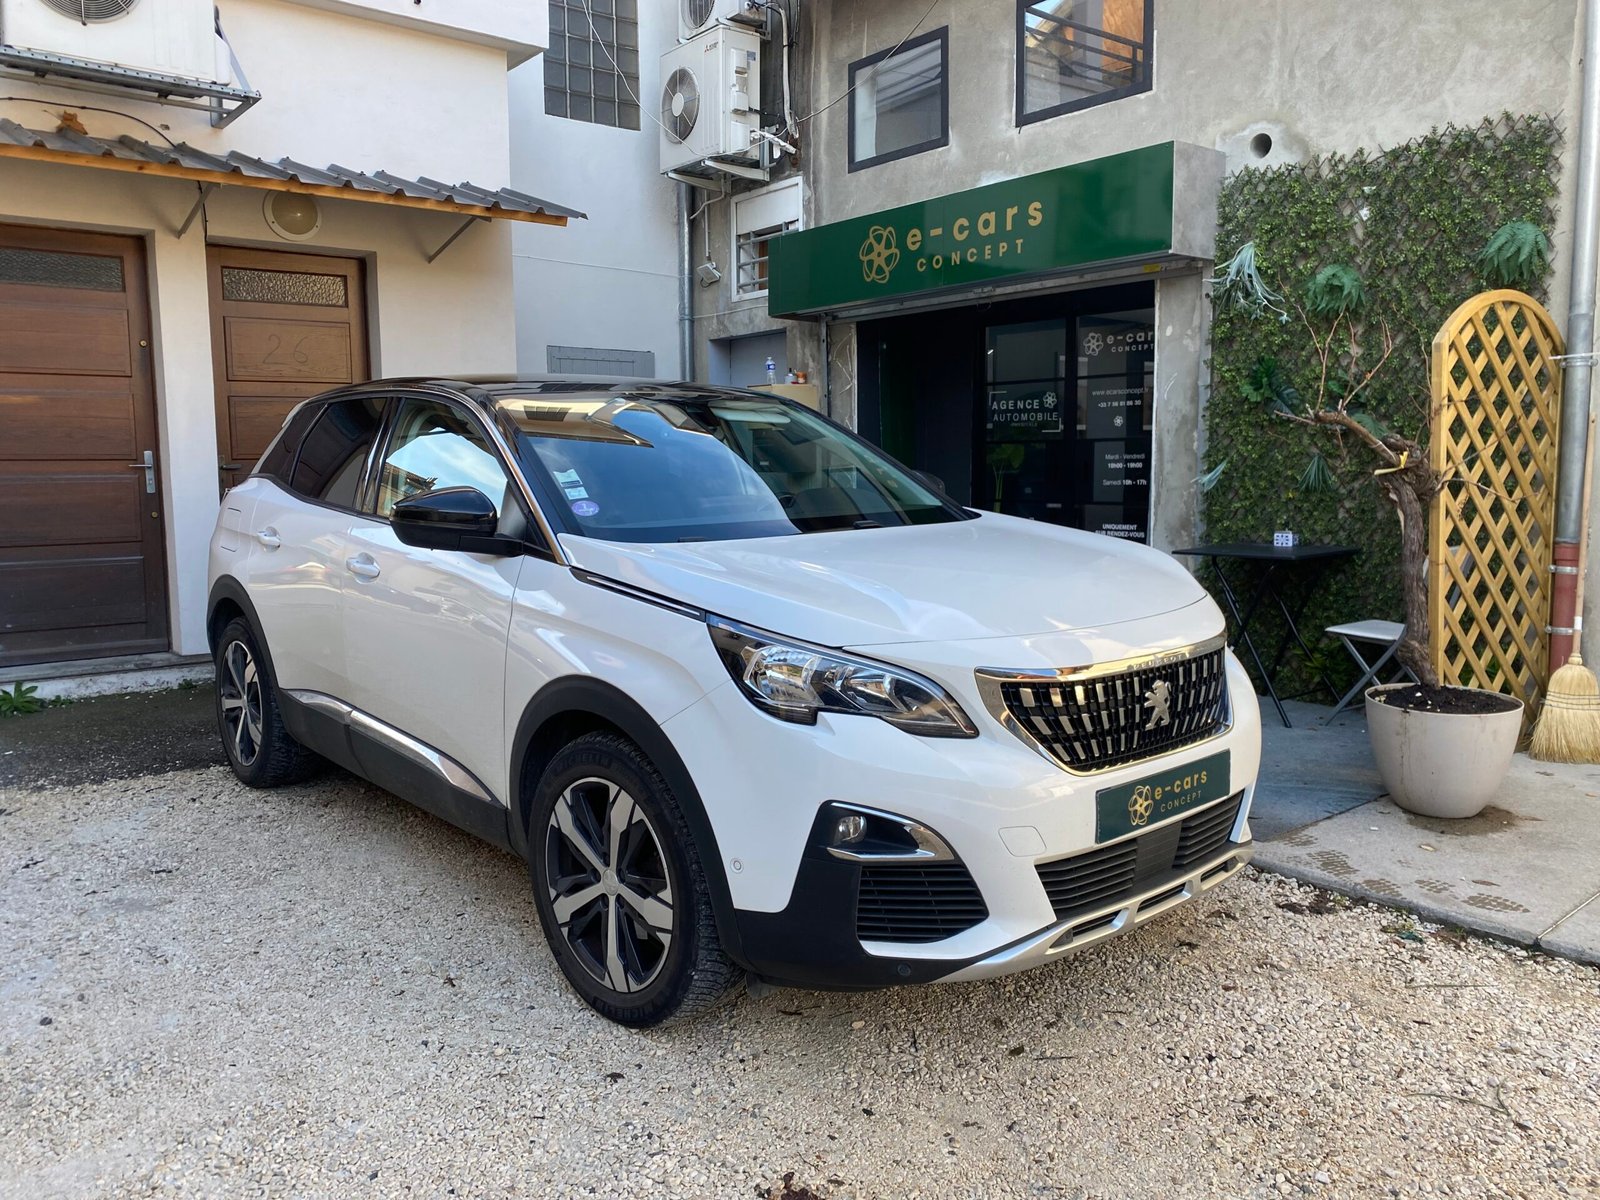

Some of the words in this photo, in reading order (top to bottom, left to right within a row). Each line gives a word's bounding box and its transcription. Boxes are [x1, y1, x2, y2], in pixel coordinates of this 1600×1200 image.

[906, 201, 1043, 251] e-cars
[917, 238, 1024, 272] CONCEPT
[1106, 331, 1154, 344] e-car
[1111, 344, 1155, 353] CONCEPT
[992, 400, 1040, 410] AGENCE
[993, 412, 1059, 422] AUTOMOBILE
[1154, 770, 1208, 799] e-cars
[1160, 790, 1202, 813] CONCEPT
